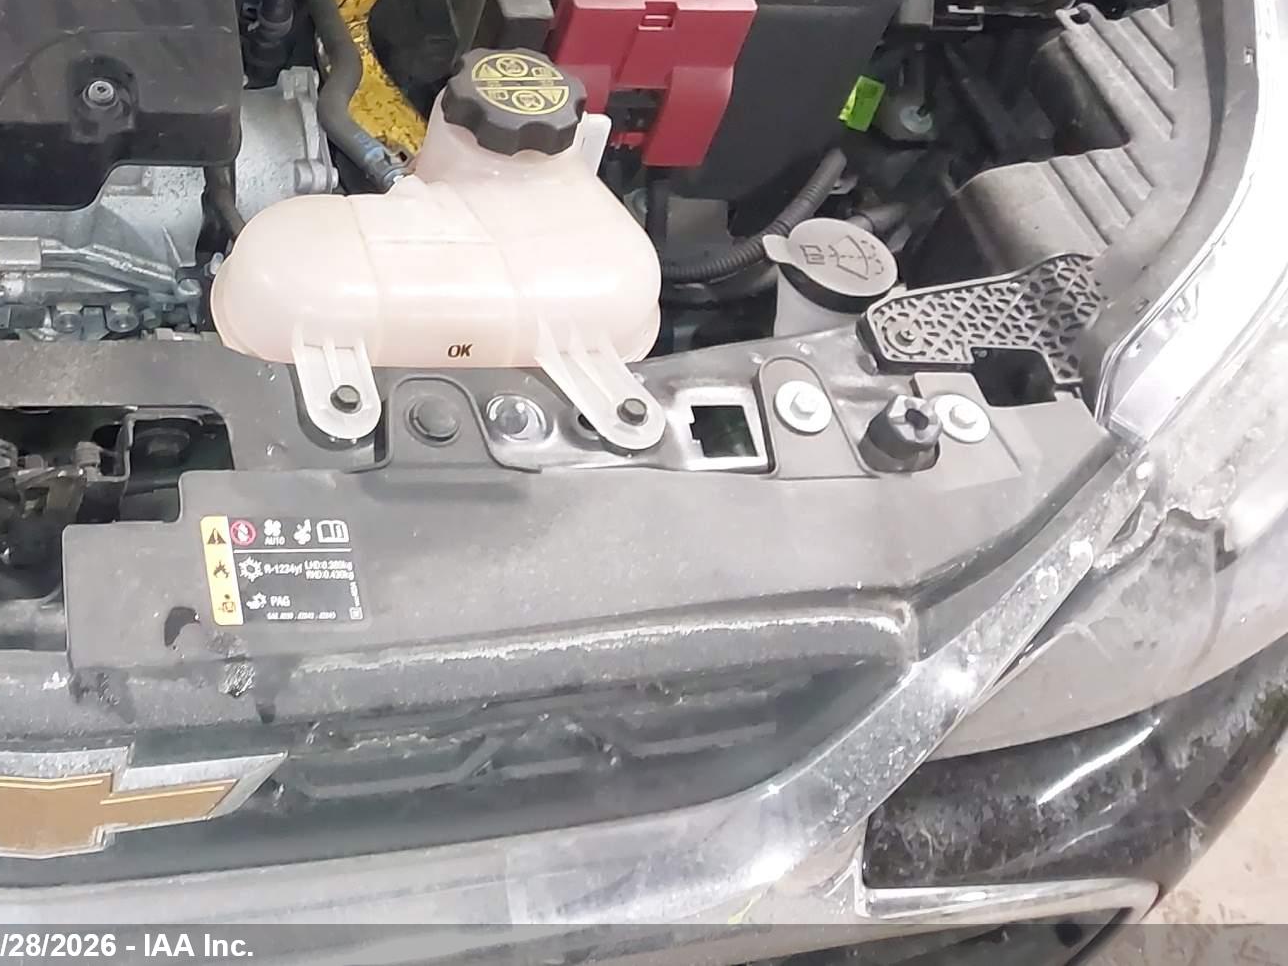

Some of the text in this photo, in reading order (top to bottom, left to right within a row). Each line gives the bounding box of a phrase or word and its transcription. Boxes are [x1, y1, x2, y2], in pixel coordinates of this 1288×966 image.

[448, 344, 472, 358] OK
[264, 536, 285, 546] AUTO
[270, 595, 290, 607] PAG
